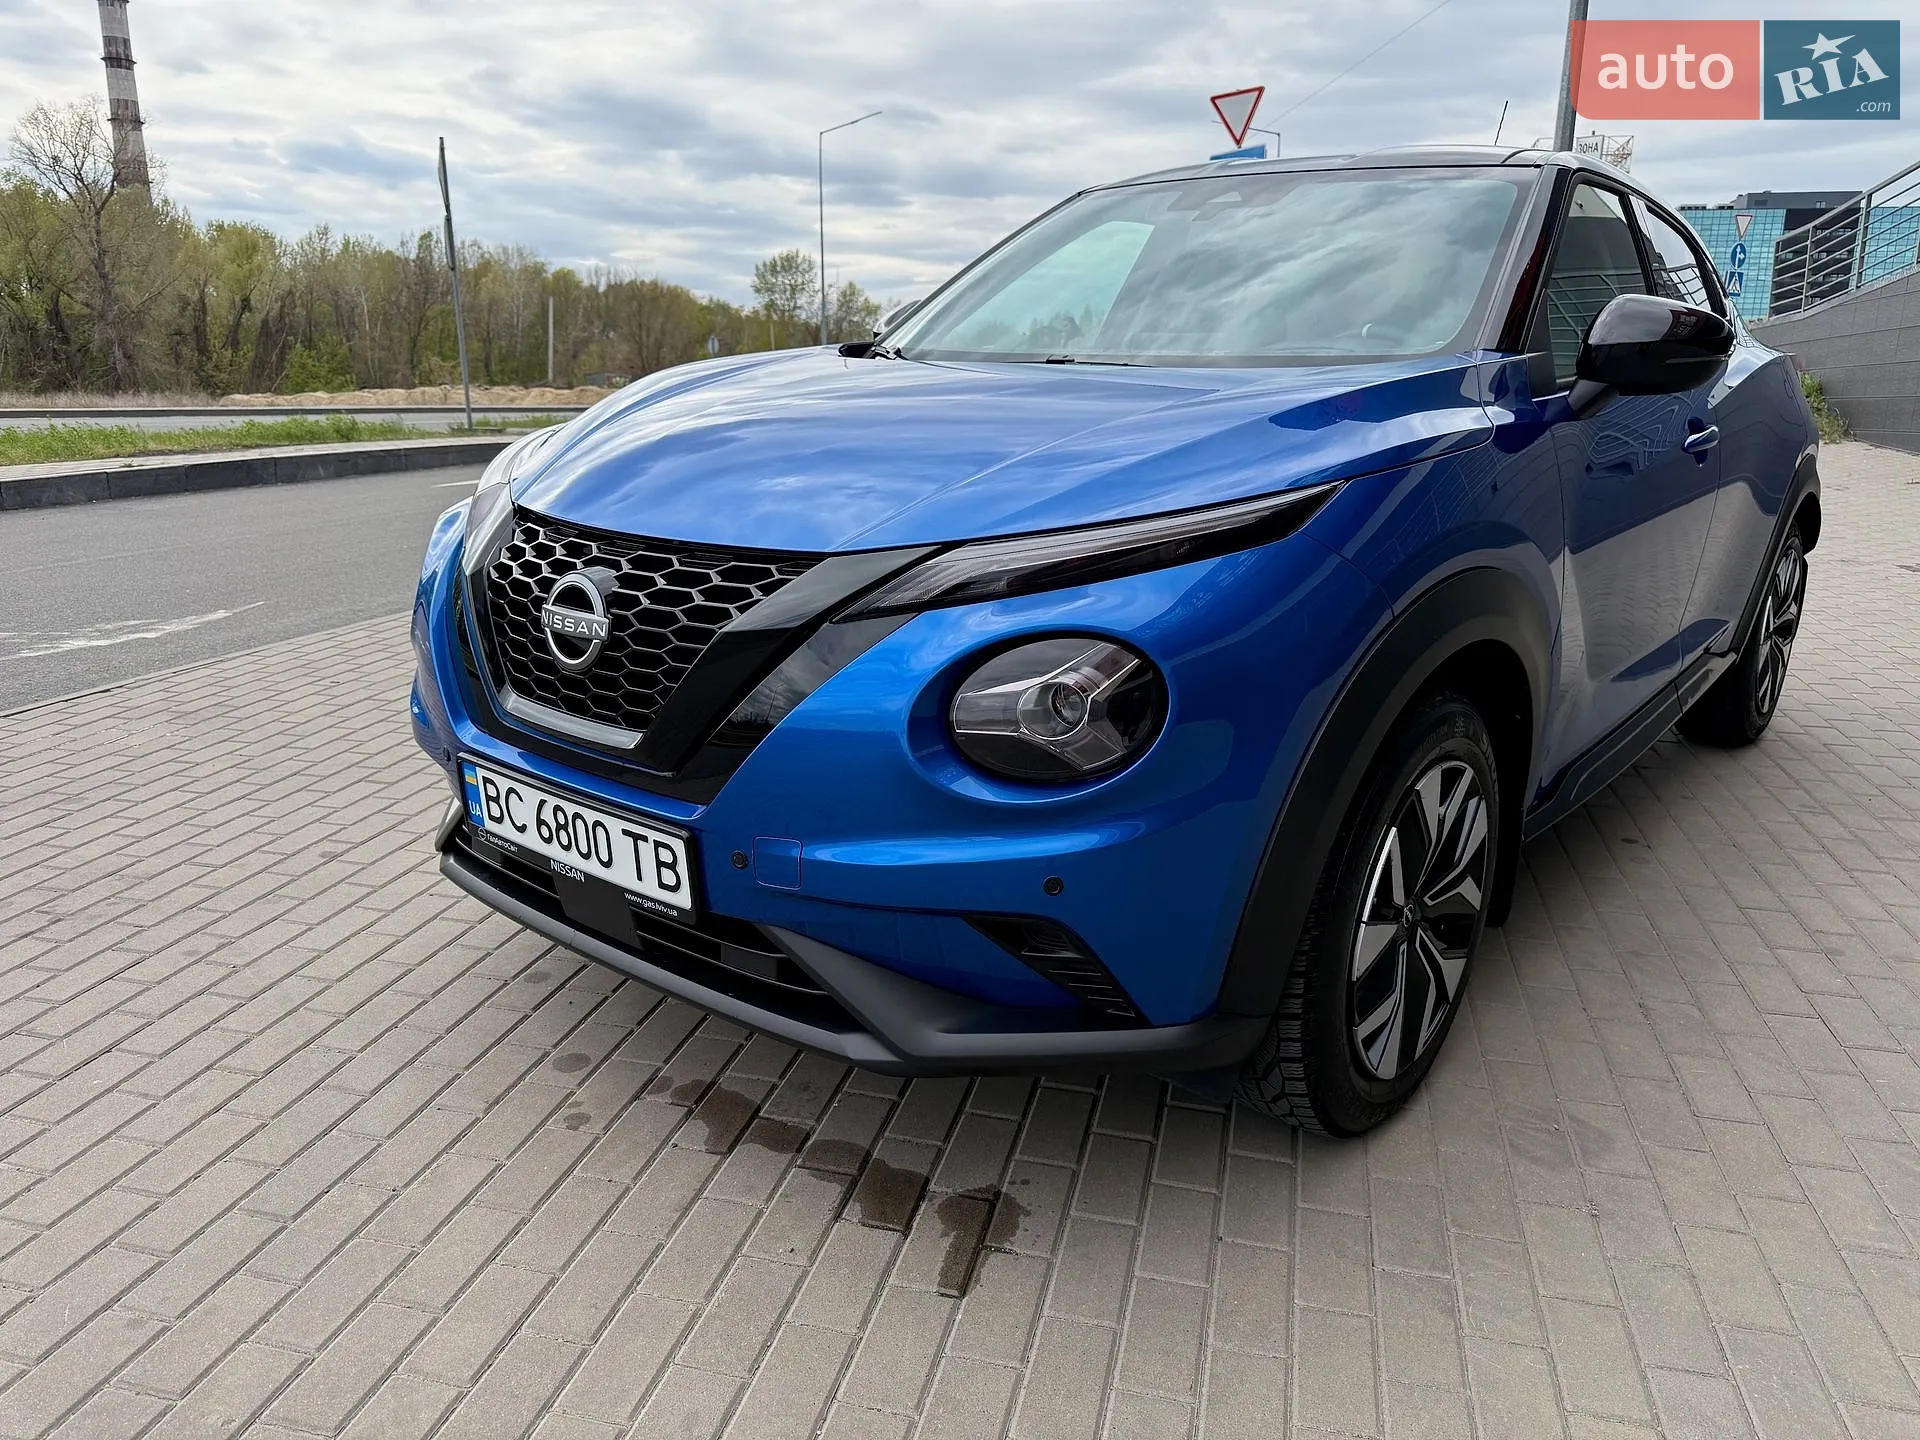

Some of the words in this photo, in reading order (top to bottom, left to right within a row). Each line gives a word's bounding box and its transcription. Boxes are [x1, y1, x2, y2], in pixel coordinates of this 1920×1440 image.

[541, 609, 606, 637] NISSAN
[469, 799, 482, 818] UA
[482, 775, 527, 834] BC
[535, 798, 613, 869] 6800
[621, 828, 682, 893] TB
[550, 859, 585, 883] NISSAN
[624, 892, 678, 917] www.gas.lviv.ua
